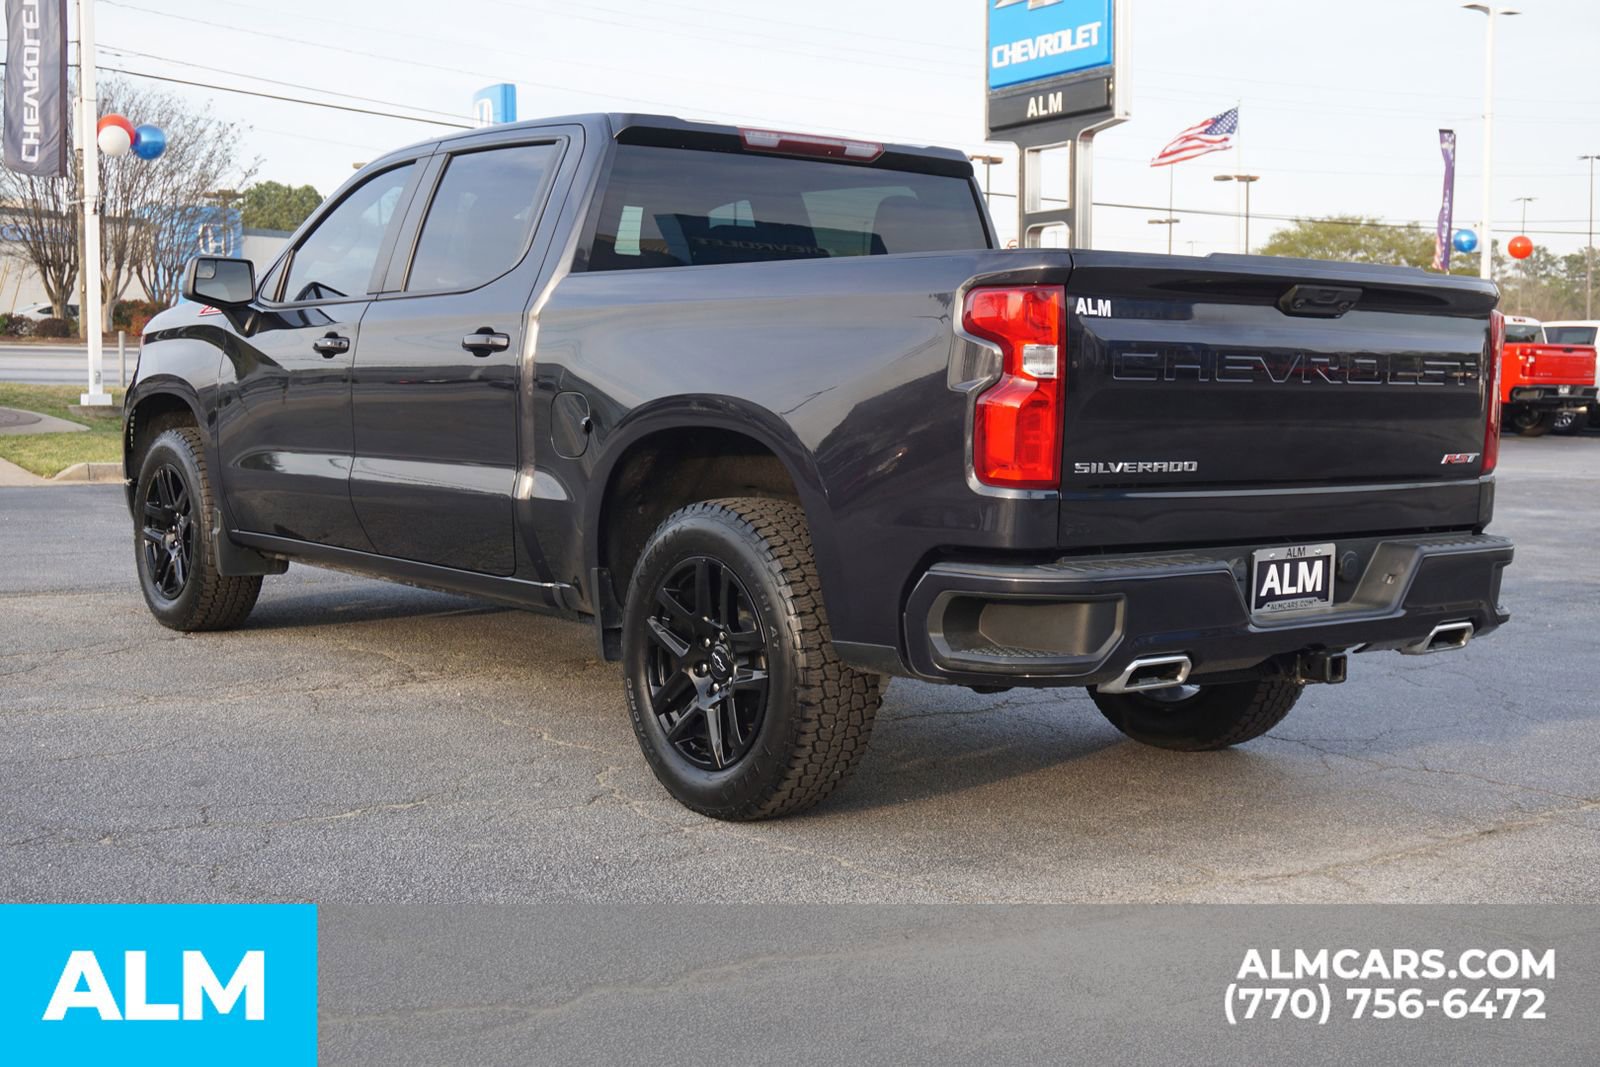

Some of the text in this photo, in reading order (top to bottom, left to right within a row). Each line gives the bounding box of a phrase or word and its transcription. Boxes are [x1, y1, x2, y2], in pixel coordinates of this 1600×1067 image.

[991, 21, 1102, 69] CHEVROLET
[1027, 91, 1063, 118] ALM
[1075, 297, 1112, 317] ALM
[1112, 350, 1477, 386] CHEVROLET
[1074, 461, 1198, 474] SILVERADO
[1441, 452, 1481, 465] RST
[1286, 547, 1306, 558] ALM
[1259, 559, 1324, 597] ALM
